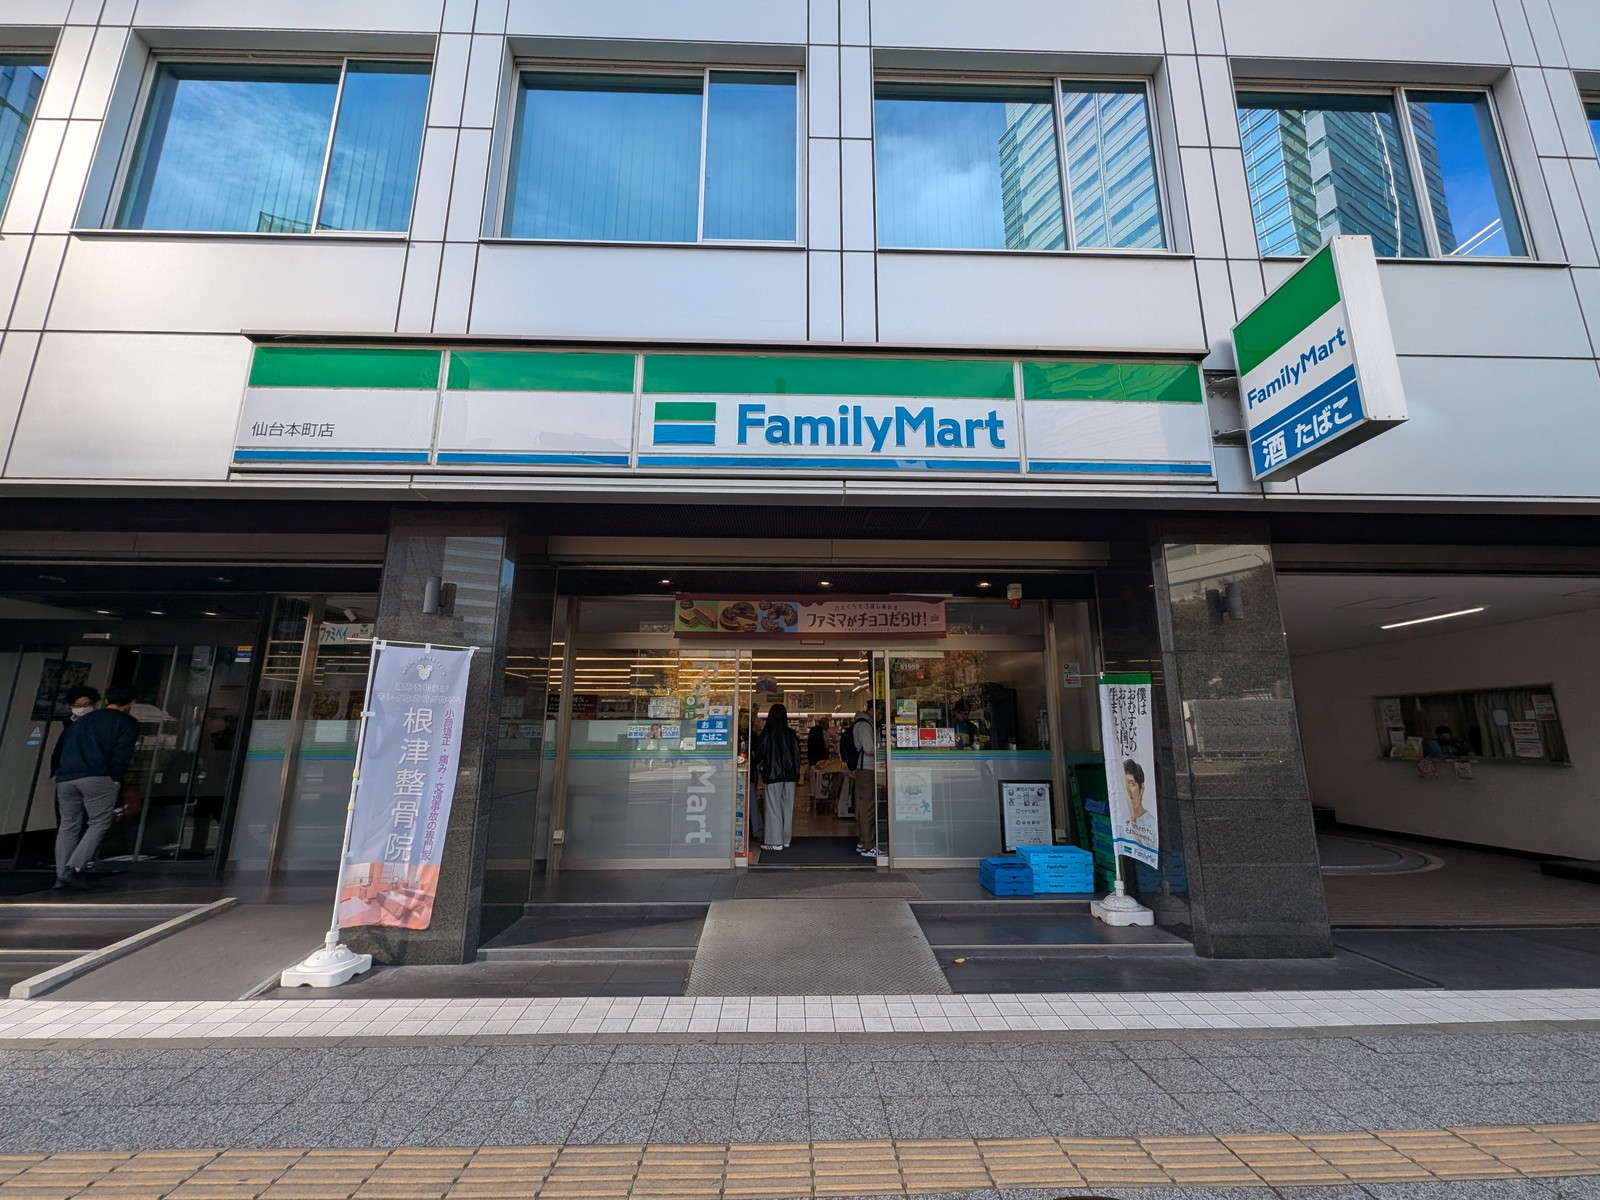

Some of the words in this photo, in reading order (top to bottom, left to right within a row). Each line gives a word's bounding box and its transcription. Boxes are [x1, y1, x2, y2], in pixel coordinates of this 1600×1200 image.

[1246, 326, 1347, 409] FamilyMart
[251, 421, 336, 438] 仙台本町店
[736, 403, 1006, 453] FamilyMart
[1261, 429, 1287, 468] 酒
[1294, 396, 1353, 448] たばこ
[1118, 687, 1130, 757] おいしい国に
[1127, 687, 1138, 753] おむすびの
[1137, 687, 1147, 716] 僕は
[384, 706, 433, 862] 根津整骨院
